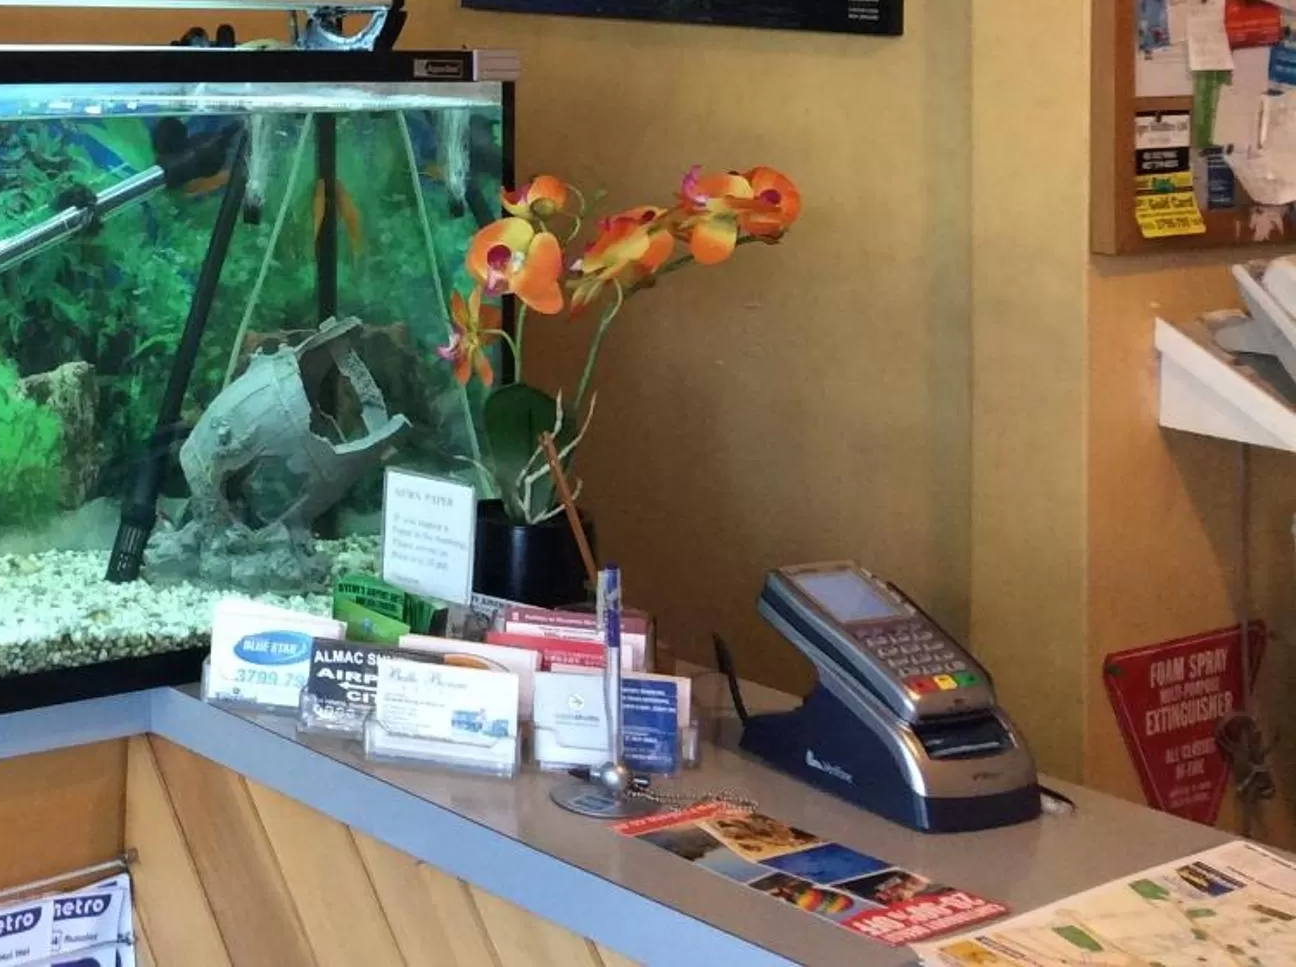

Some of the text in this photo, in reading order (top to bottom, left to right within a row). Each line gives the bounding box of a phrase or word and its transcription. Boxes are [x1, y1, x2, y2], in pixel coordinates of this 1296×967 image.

[314, 650, 364, 665] ALMAC
[1150, 648, 1229, 688] FOAM SPRAY
[1145, 691, 1234, 736] EXTINGUISHER
